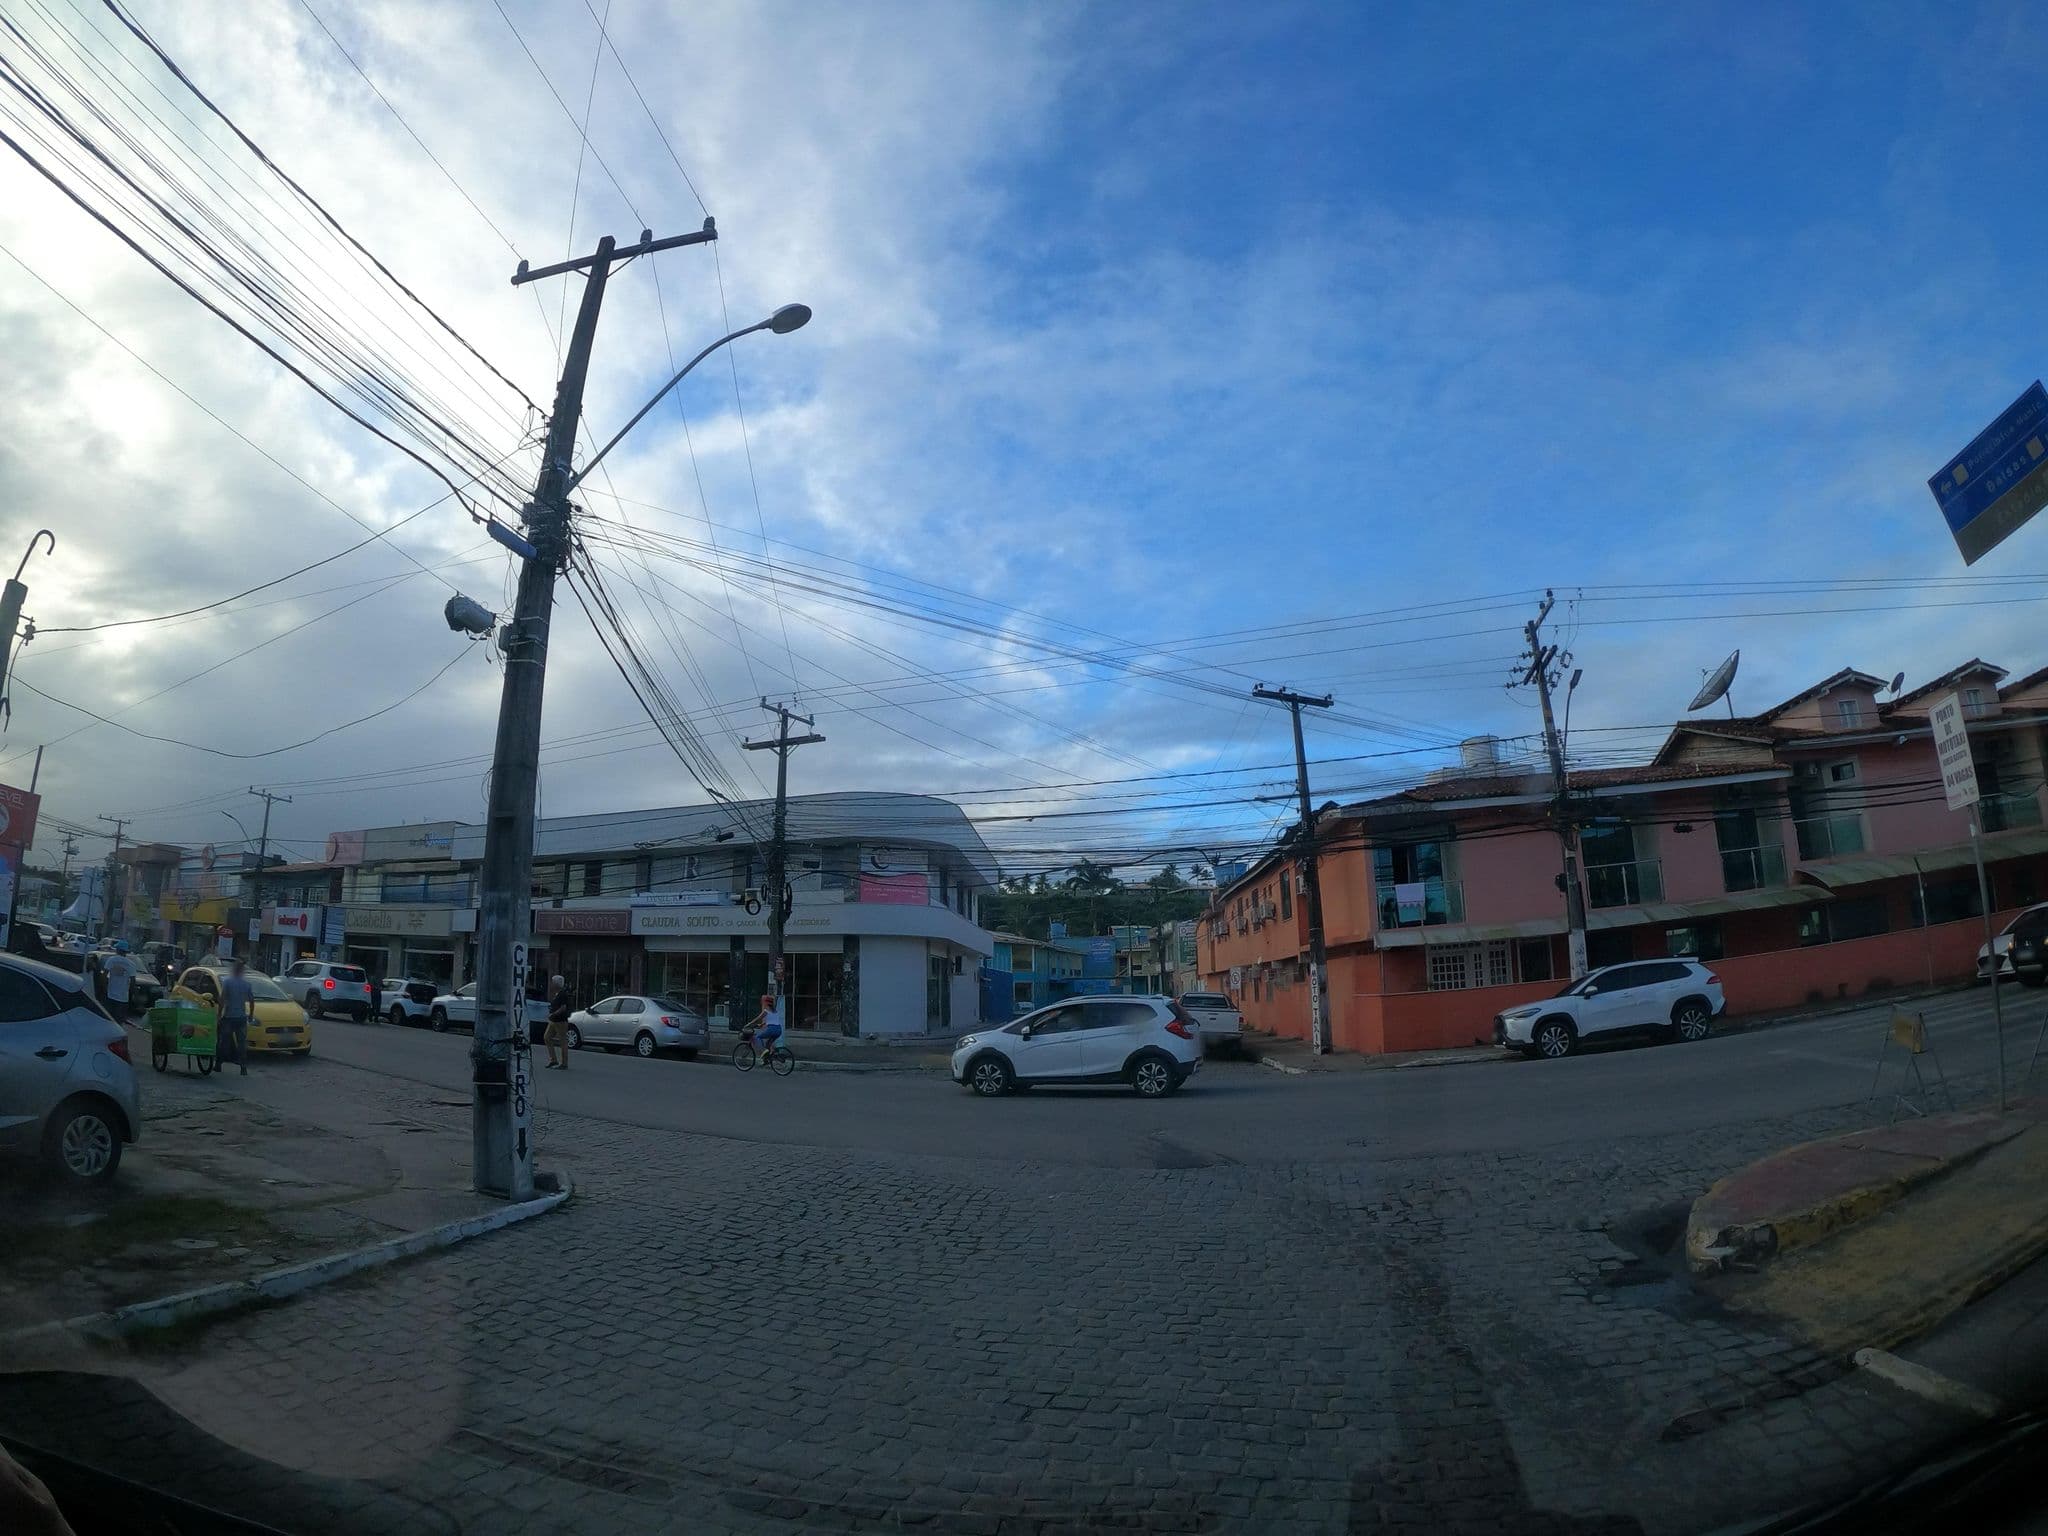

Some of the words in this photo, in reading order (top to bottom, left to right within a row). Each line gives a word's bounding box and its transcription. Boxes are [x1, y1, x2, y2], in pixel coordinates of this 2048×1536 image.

[1935, 703, 1954, 723] PONTO
[1944, 721, 1953, 736] DE
[641, 916, 680, 928] CLAUDIA
[687, 916, 720, 927] SOUTO
